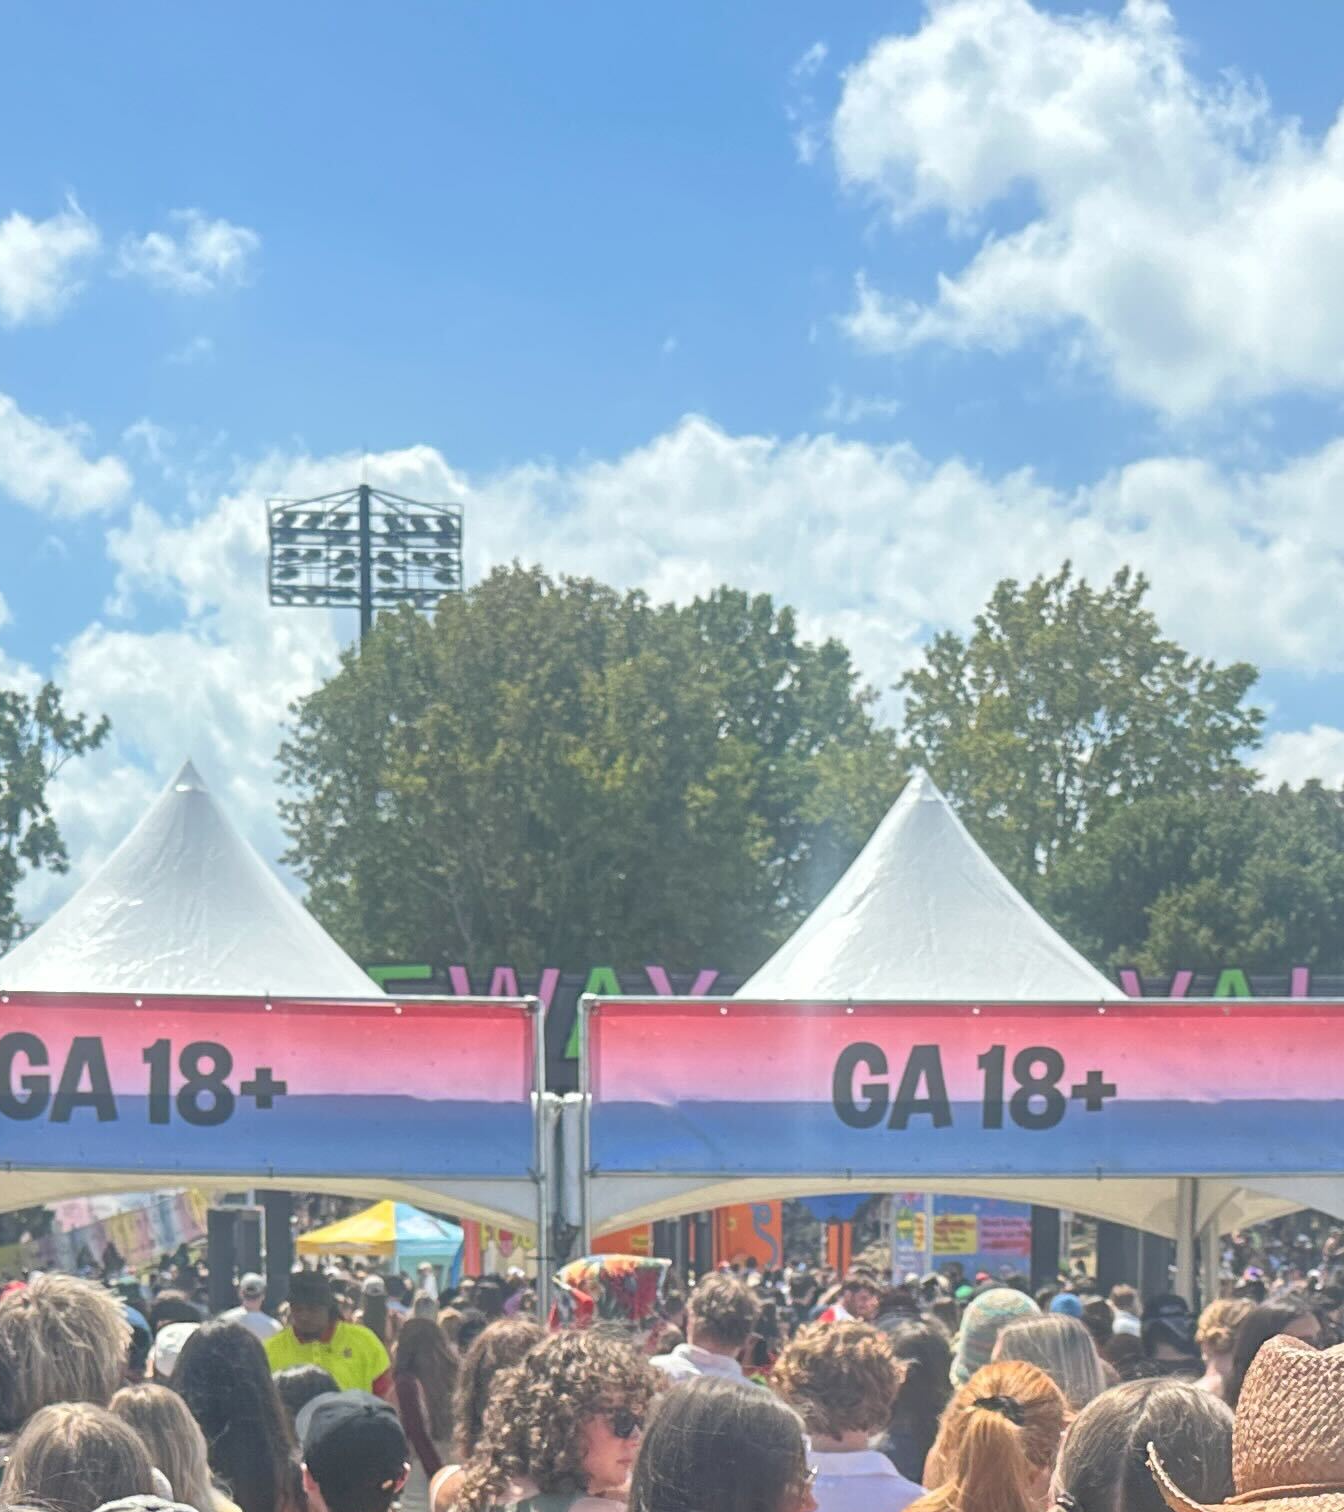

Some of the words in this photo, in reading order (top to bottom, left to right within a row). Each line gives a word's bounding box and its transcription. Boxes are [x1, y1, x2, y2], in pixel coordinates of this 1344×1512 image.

[142, 1038, 287, 1126] 18+
[833, 1041, 952, 1130] GA
[977, 1044, 1117, 1130] 18+
